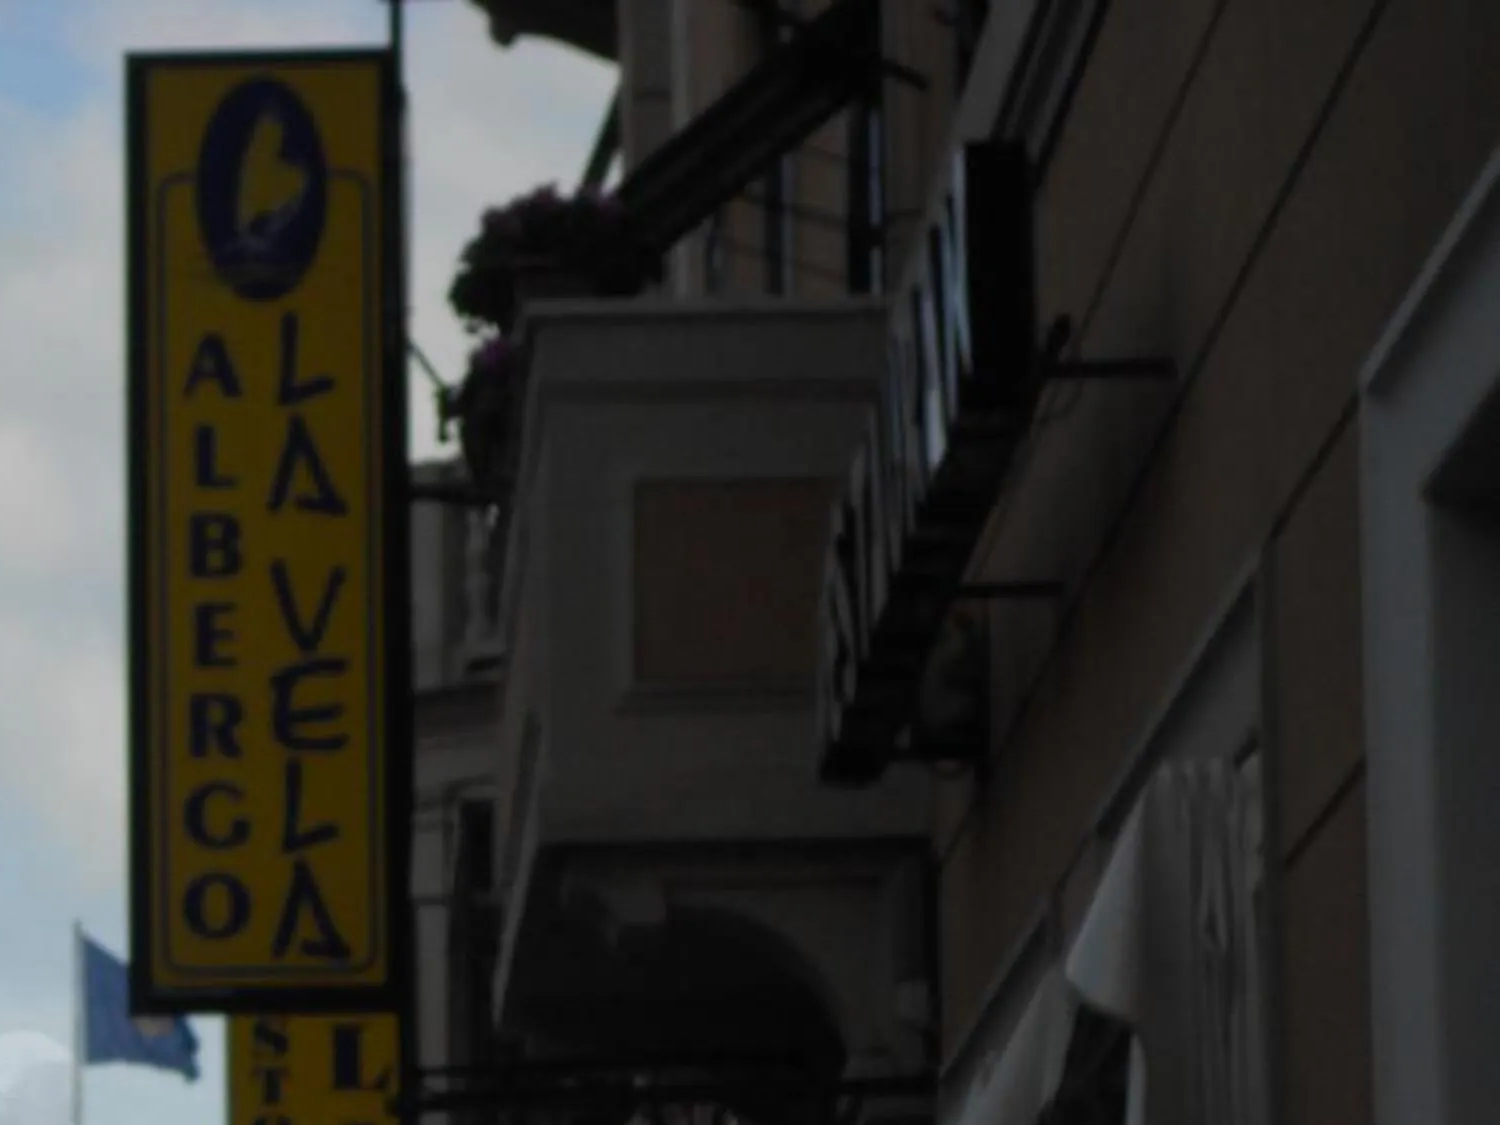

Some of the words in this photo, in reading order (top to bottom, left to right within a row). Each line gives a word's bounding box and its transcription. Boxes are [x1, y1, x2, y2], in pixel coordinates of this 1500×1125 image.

[266, 312, 349, 518] LA
[184, 334, 252, 940] ALBERGO
[269, 558, 352, 961] VELA
